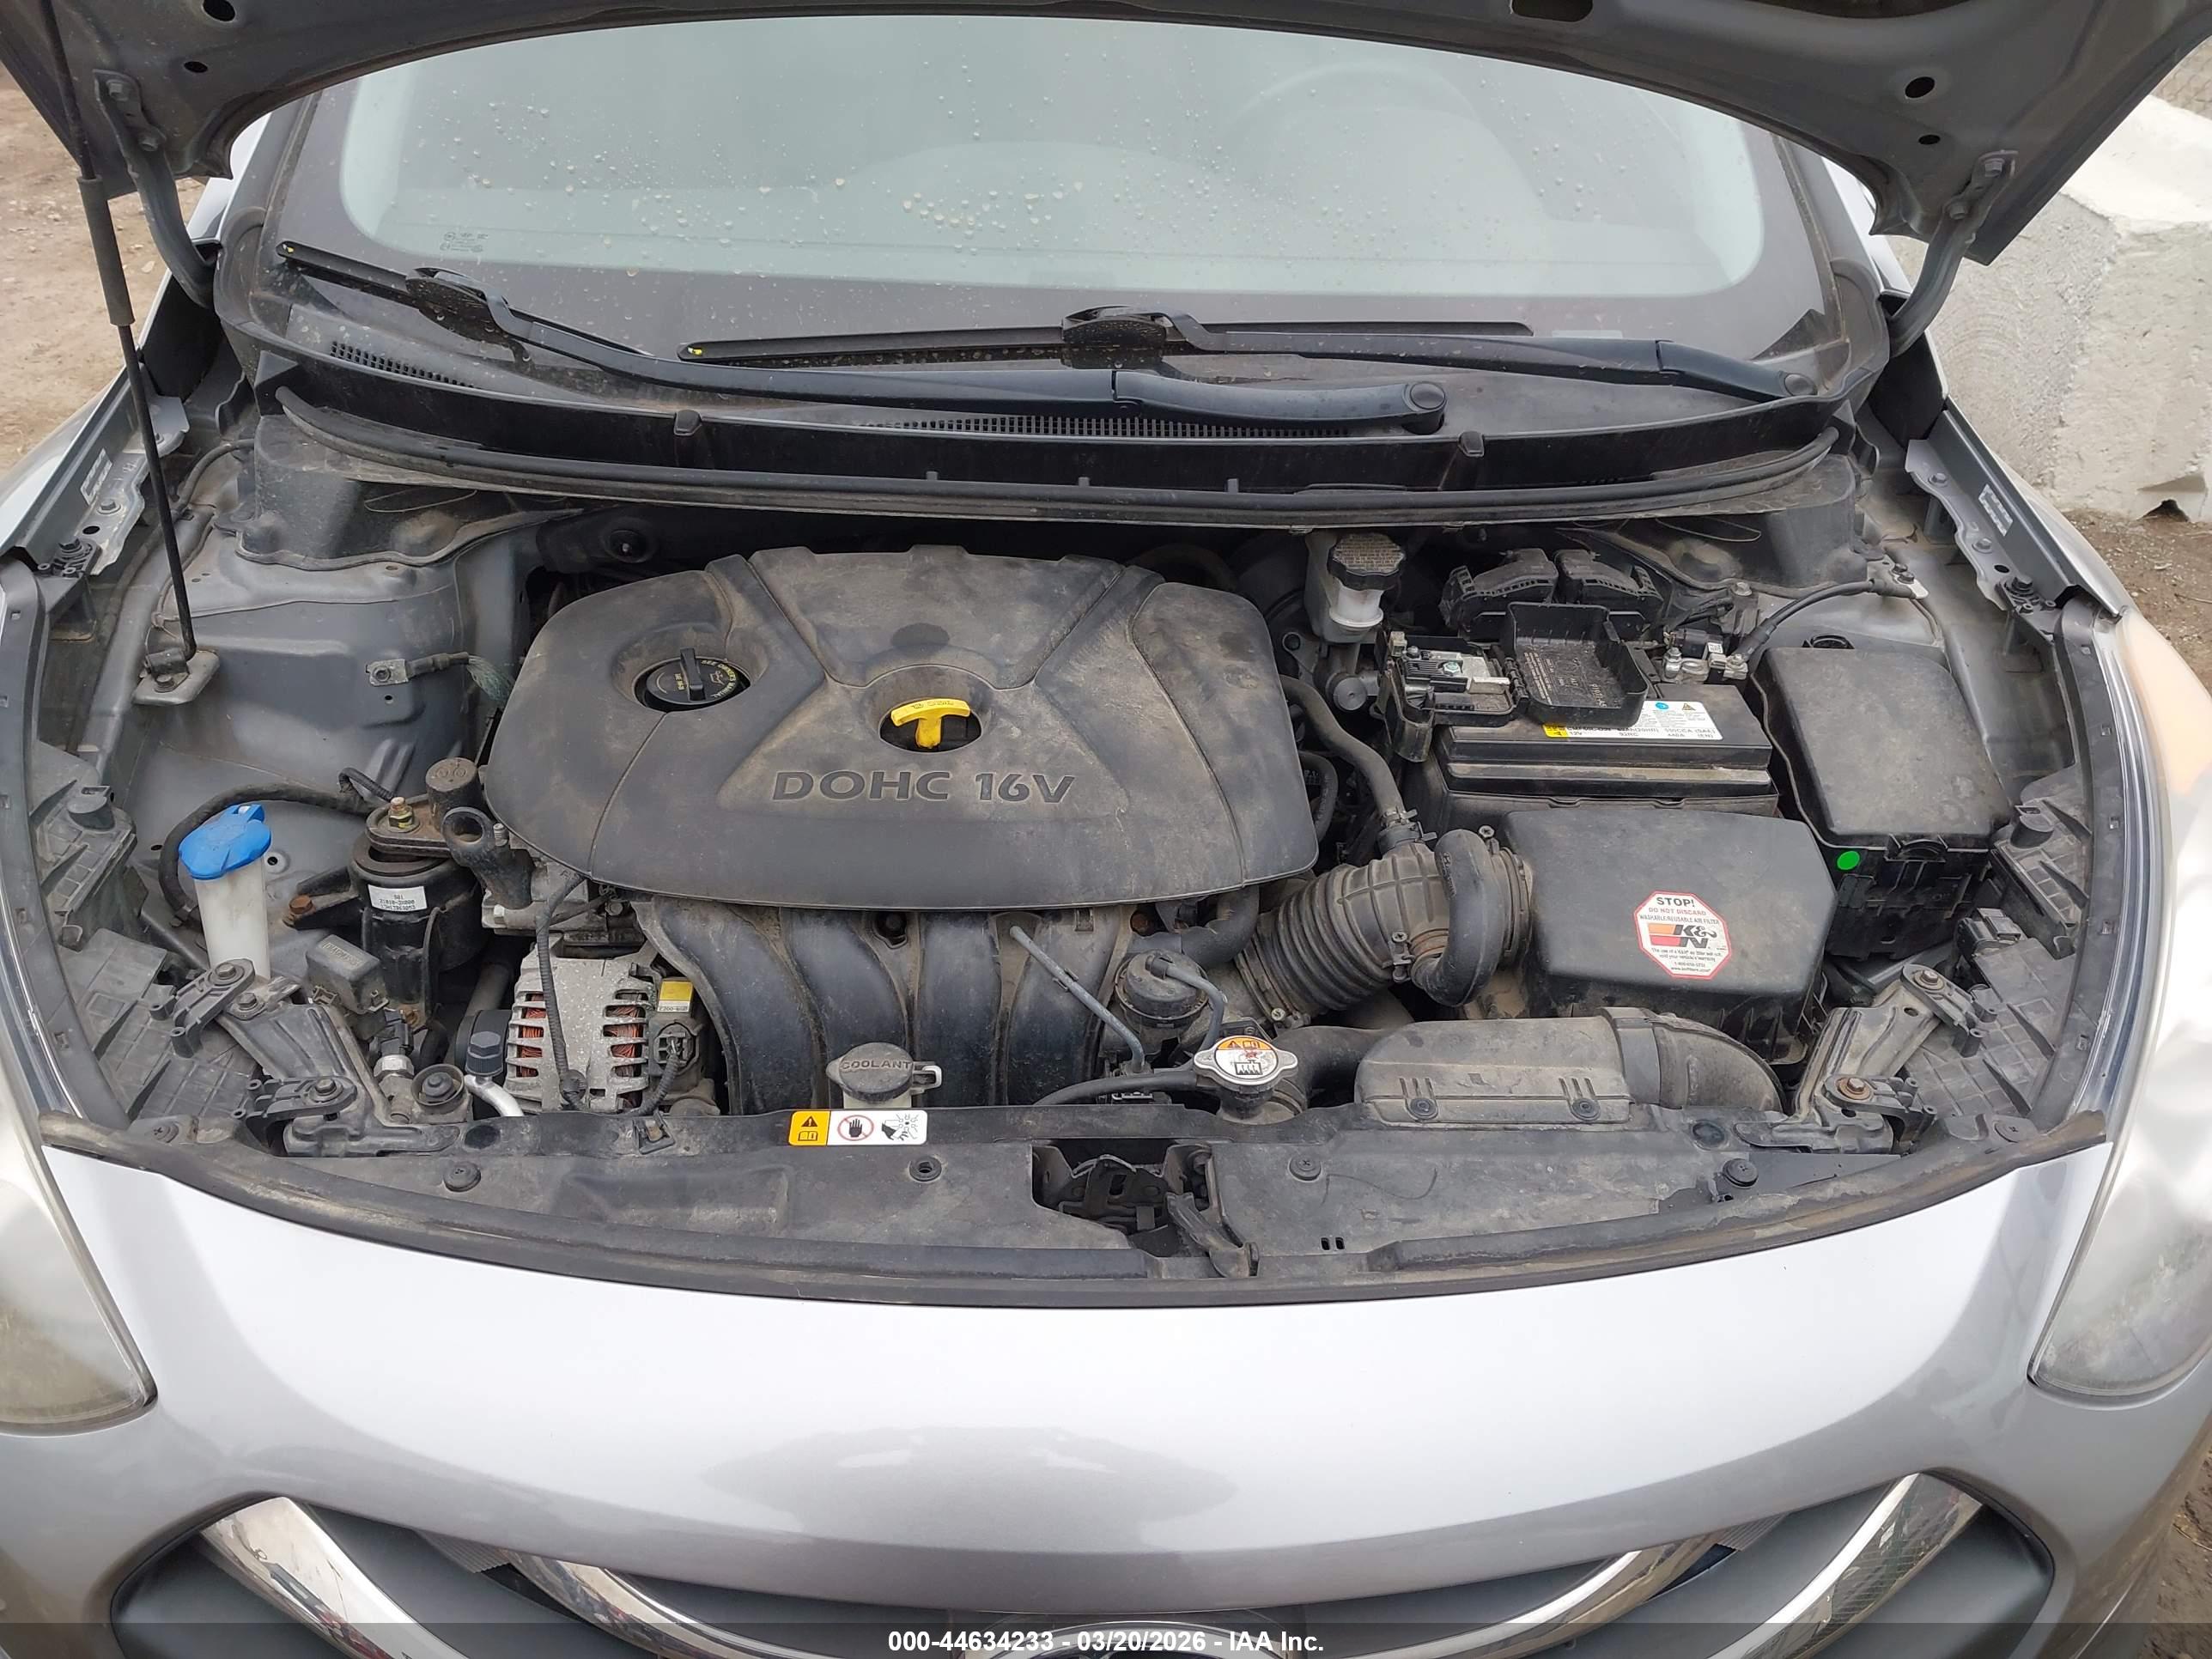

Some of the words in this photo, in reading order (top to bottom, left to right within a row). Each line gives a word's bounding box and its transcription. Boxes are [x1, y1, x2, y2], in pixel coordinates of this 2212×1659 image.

[772, 769, 951, 801] DOHC
[975, 772, 1076, 804] 16V
[1656, 896, 1695, 908] STOP!
[842, 1060, 911, 1071] COOLANT
